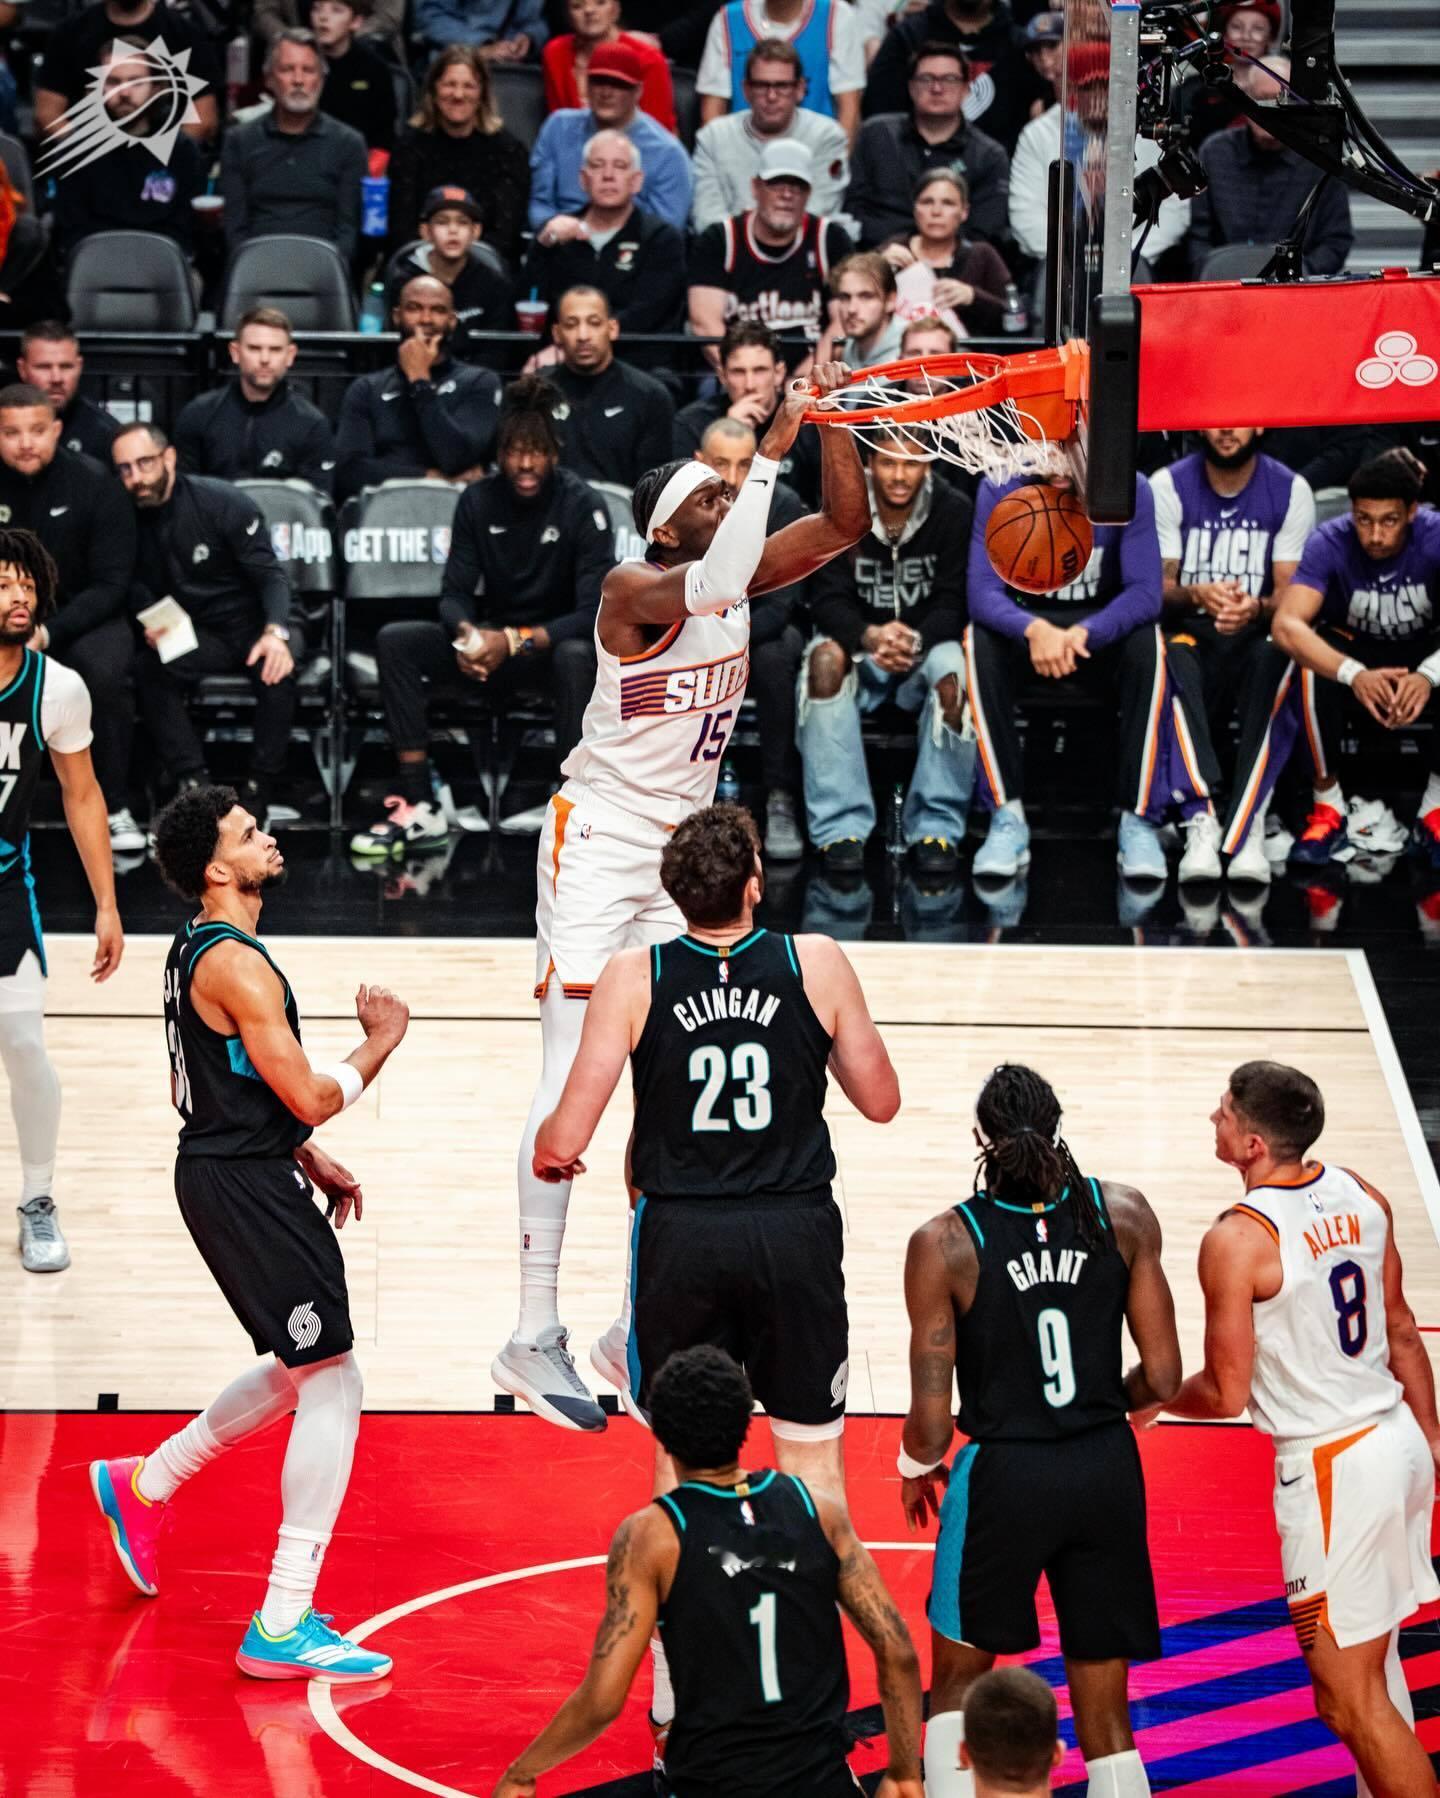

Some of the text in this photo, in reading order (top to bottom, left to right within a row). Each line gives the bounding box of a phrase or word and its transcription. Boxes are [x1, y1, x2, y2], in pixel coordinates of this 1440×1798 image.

[292, 522, 332, 564] App
[344, 527, 429, 563] GET THE
[690, 709, 742, 763] 15
[673, 987, 781, 1032] CLINGAN
[689, 1042, 772, 1132] 23
[1303, 1214, 1361, 1261] ALLEN
[1006, 1249, 1088, 1292] GRANT
[1328, 1259, 1368, 1359] 8
[1037, 1307, 1077, 1408] 9
[749, 1592, 783, 1702] 1
